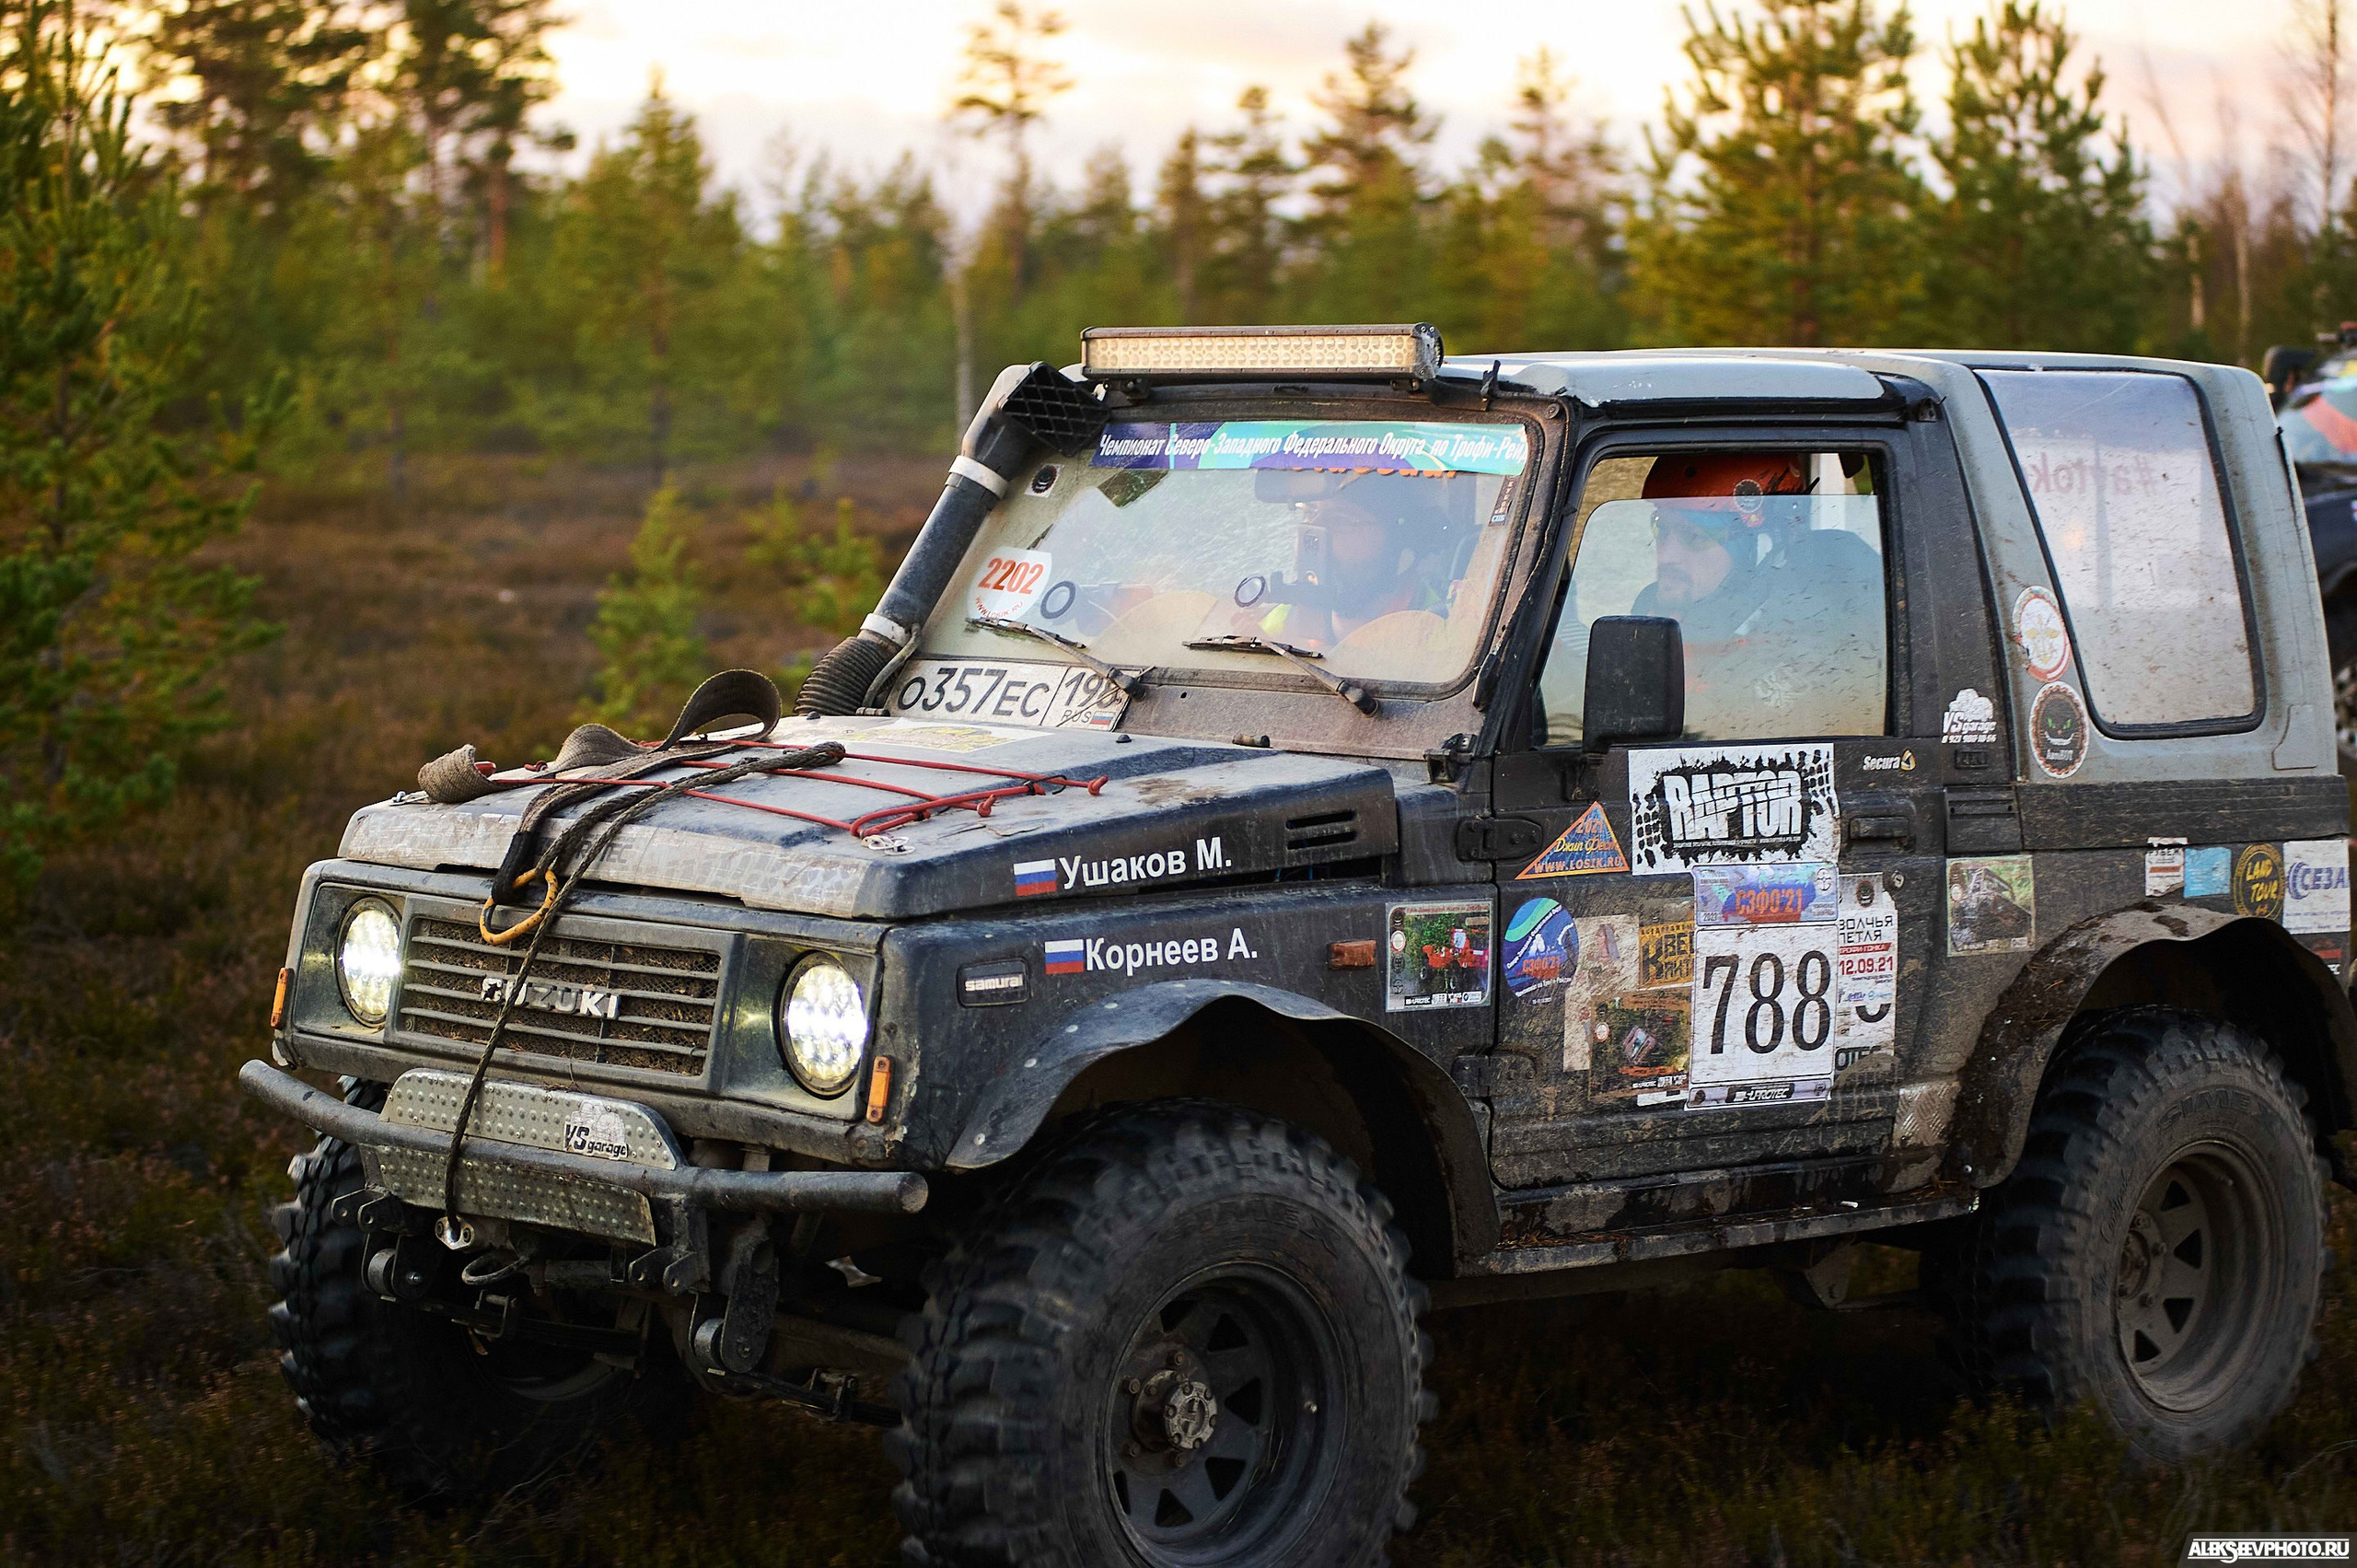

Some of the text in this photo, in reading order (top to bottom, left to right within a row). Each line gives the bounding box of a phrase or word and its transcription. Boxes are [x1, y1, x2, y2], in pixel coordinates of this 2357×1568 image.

[1099, 435, 1167, 456] Чемпионат
[1165, 433, 1283, 459] Северо-Западного
[1283, 432, 1378, 458] Федерального
[1378, 432, 1425, 459] Округа
[1430, 438, 1448, 457] по
[978, 557, 1044, 595] 2202
[1061, 709, 1092, 723] RUS
[1943, 711, 1997, 734] VS garage
[1863, 756, 1900, 771] Secura
[1663, 771, 1803, 840] RAPTOR
[1576, 819, 1603, 834] 2021
[1554, 838, 1585, 853] Джип
[1058, 836, 1232, 890] Ушаков М.
[1534, 856, 1621, 873] WWW.LOSIK.RU
[2246, 859, 2272, 881] LAND
[1735, 889, 1803, 914] СЗФО'21
[2251, 880, 2278, 902] TOUR
[1086, 927, 1258, 976] Корнеев А.
[1839, 957, 1893, 975] 12.09.21
[965, 973, 1023, 992] samurai
[1702, 950, 1831, 1055] 788
[564, 1124, 627, 1157] VS garage
